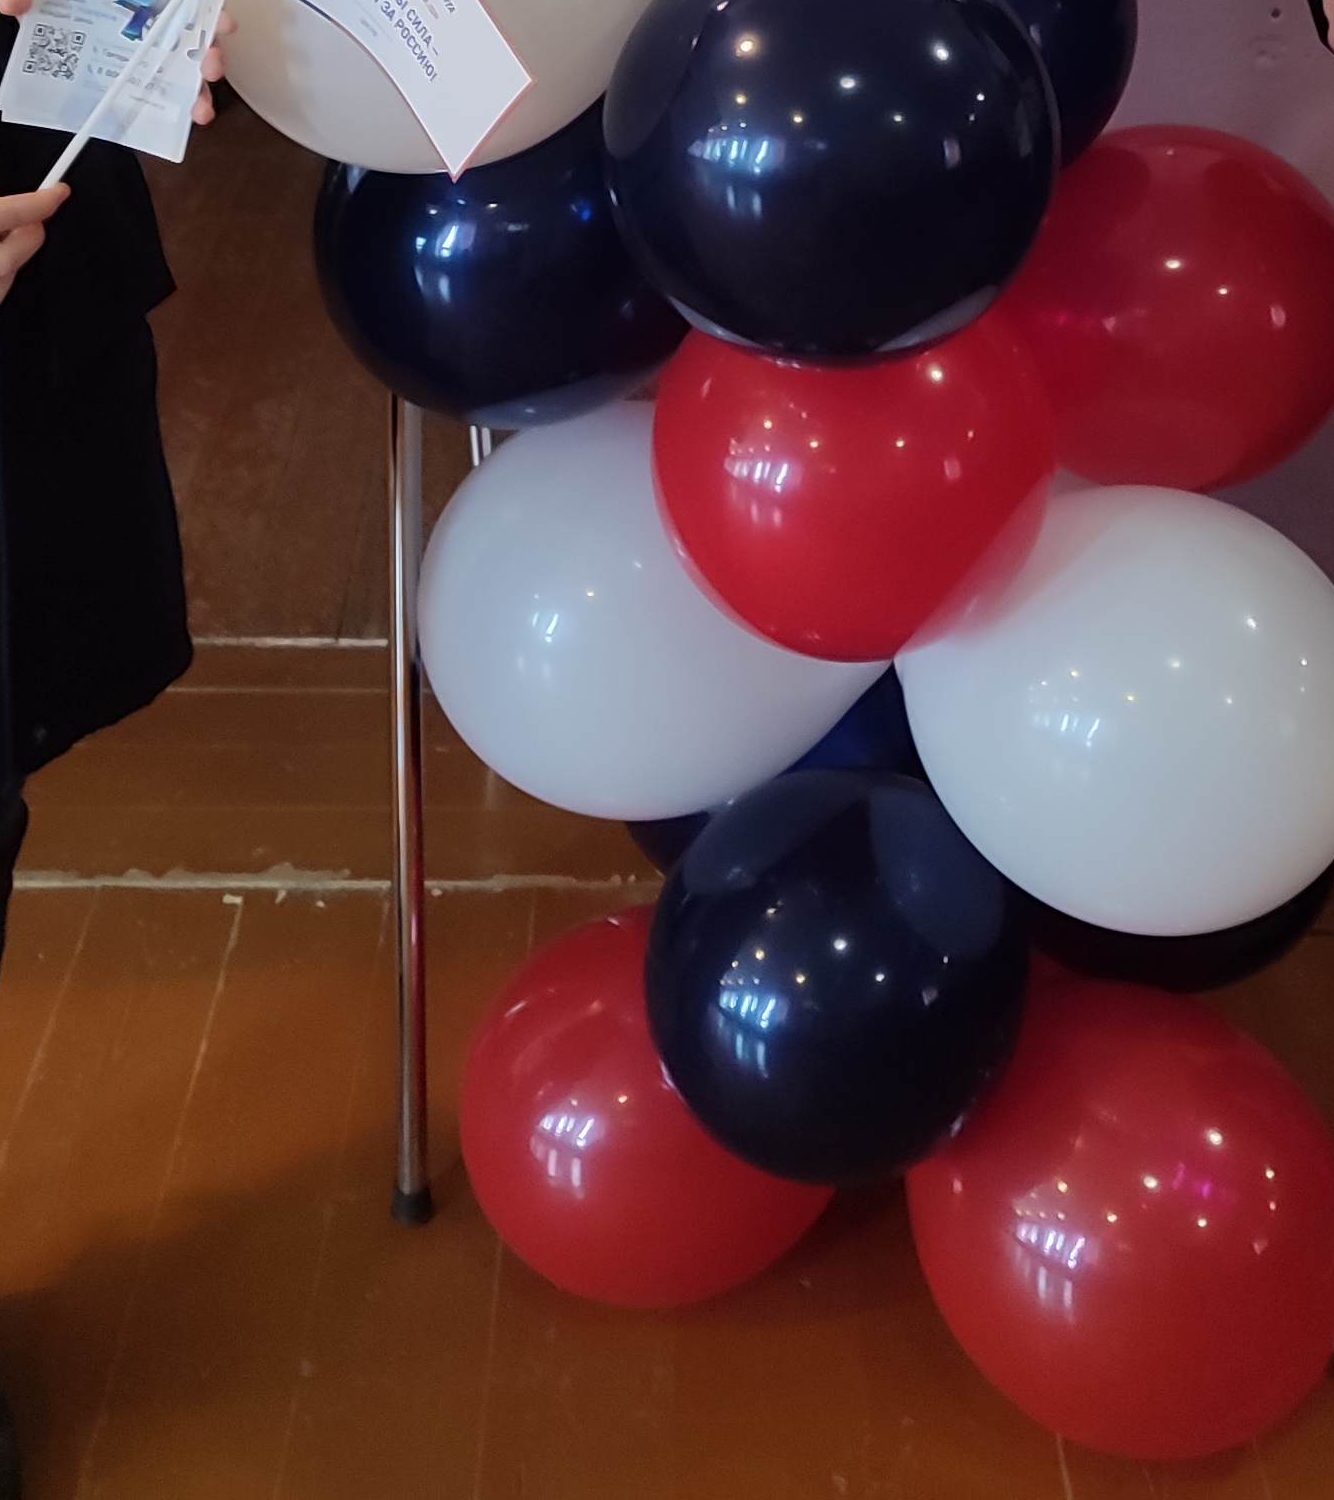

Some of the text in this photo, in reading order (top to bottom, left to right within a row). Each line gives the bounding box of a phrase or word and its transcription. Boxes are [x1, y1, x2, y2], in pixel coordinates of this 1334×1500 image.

[379, 0, 396, 22] ЗА
[393, 17, 439, 83] РОССИЮ!
[405, 8, 433, 49] СИЛА
